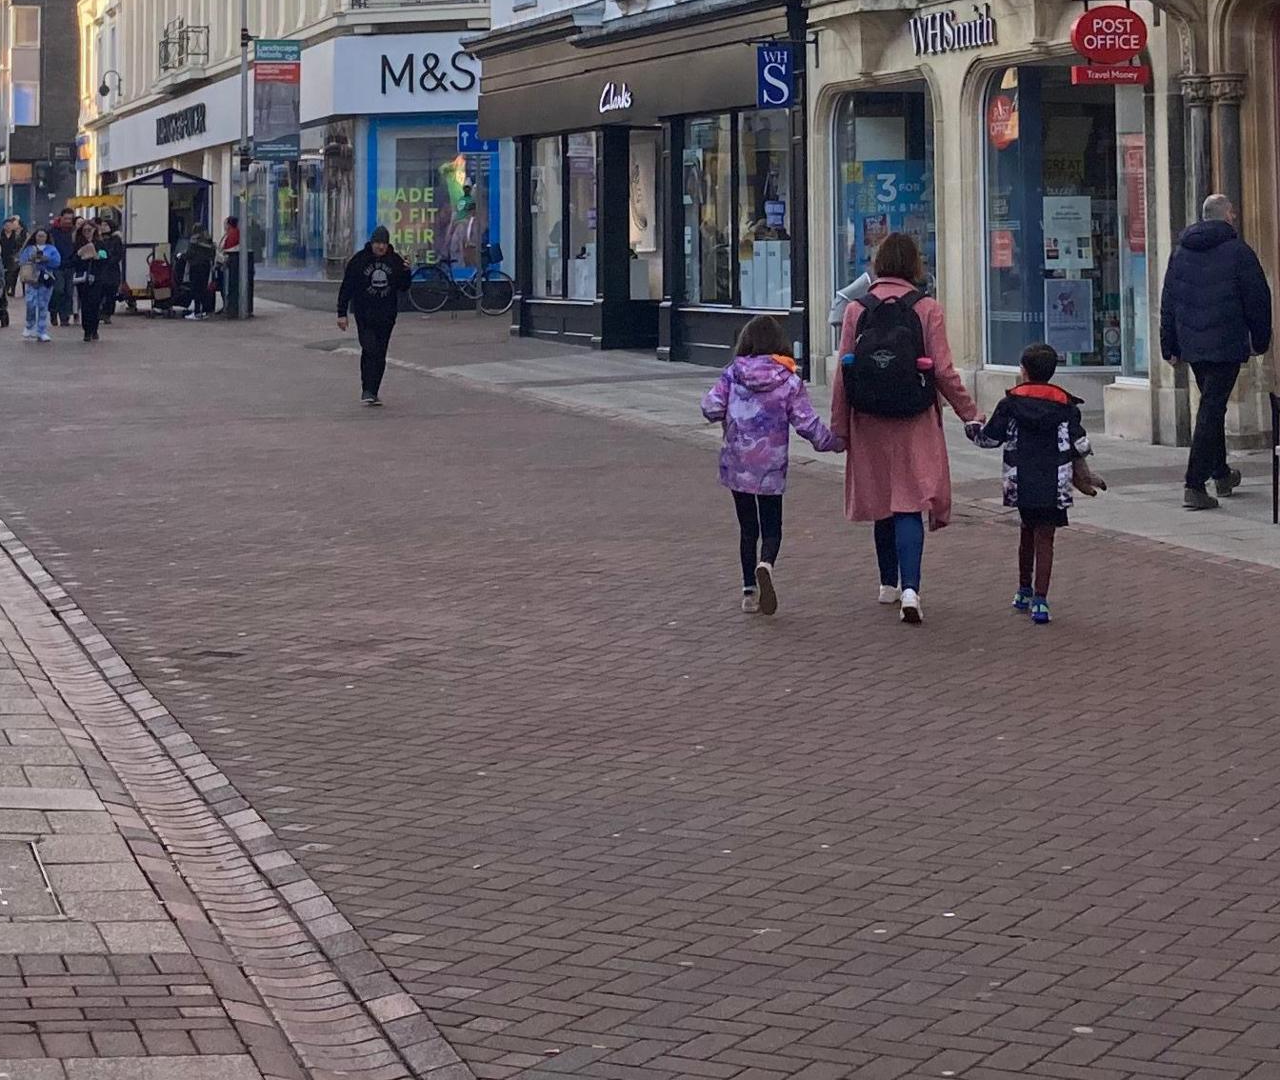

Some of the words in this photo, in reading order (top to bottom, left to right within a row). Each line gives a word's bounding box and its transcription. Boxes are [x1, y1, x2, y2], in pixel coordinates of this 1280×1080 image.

[909, 3, 994, 56] WHSmith
[1092, 18, 1134, 33] POST
[1083, 34, 1140, 50] OFFICE
[763, 50, 788, 63] WH
[380, 50, 476, 95] M&S
[1088, 69, 1111, 80] Travel
[1112, 70, 1138, 82] Money
[763, 63, 789, 105] S
[599, 81, 632, 113] Clarks
[377, 186, 435, 203] MADE
[876, 173, 897, 202] 3
[899, 183, 920, 192] FOR
[410, 207, 439, 224] FIT
[877, 203, 897, 212] Mix
[391, 228, 435, 245] HEIR
